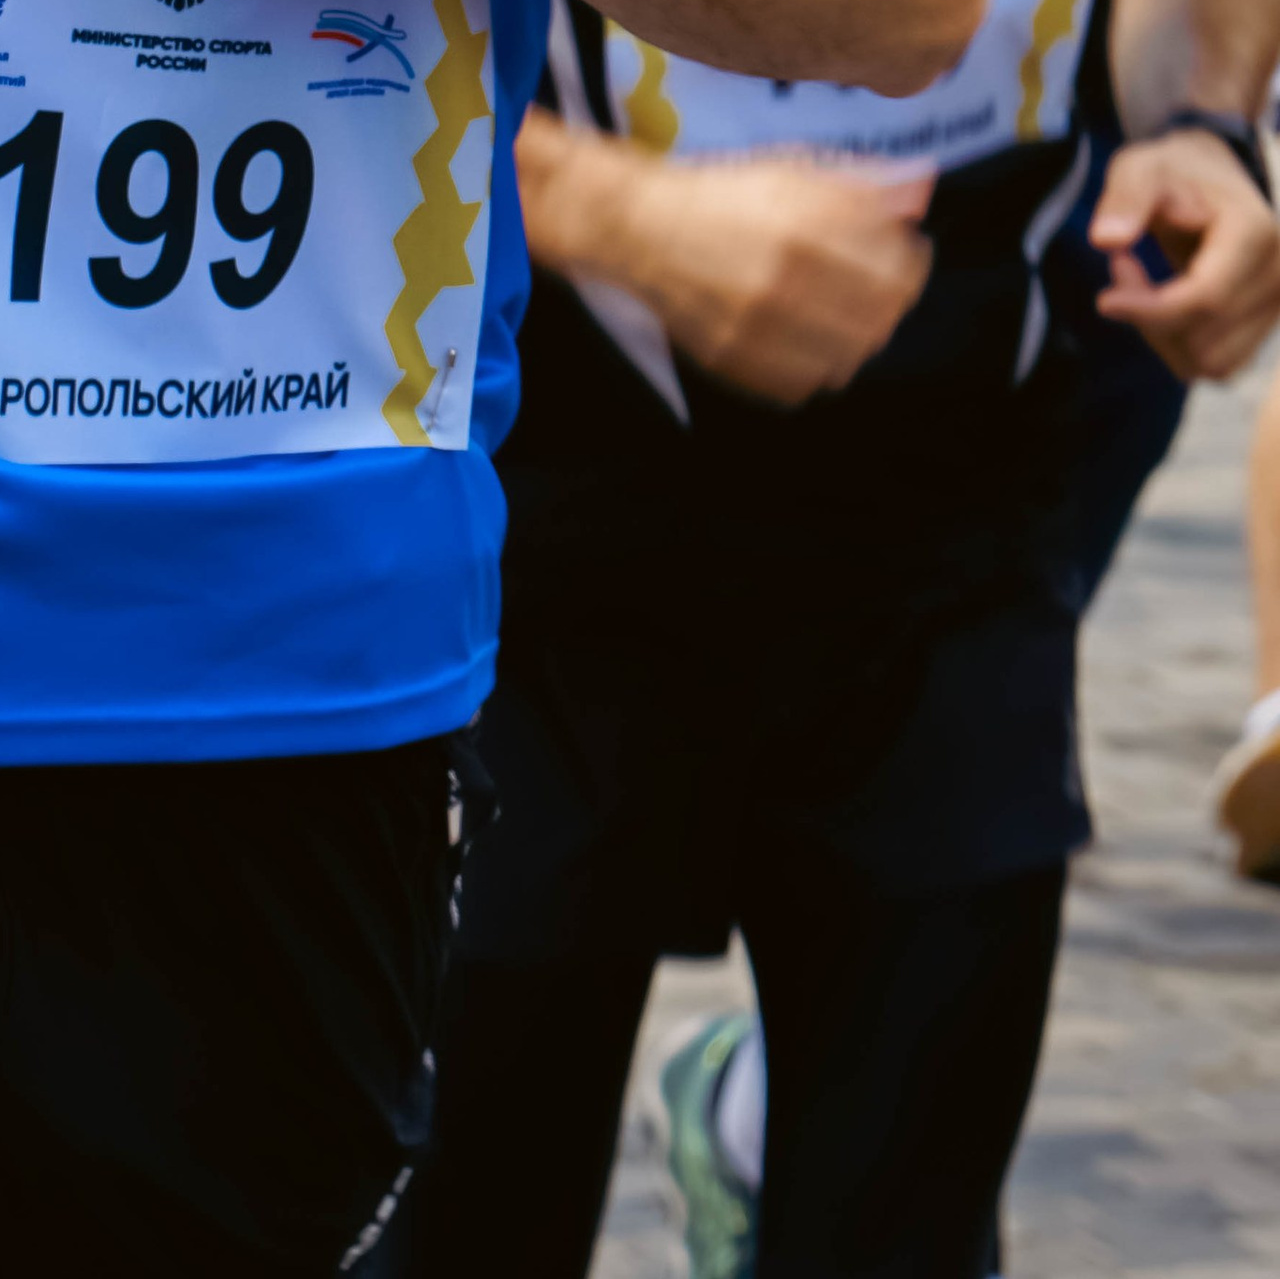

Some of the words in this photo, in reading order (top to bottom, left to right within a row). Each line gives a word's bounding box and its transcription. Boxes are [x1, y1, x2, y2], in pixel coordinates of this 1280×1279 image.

[71, 27, 206, 53] МИНИСТЕРСТВО
[208, 38, 273, 56] СПОРТА
[135, 53, 208, 73] РОССИИ
[260, 360, 351, 413] КРАЙ
